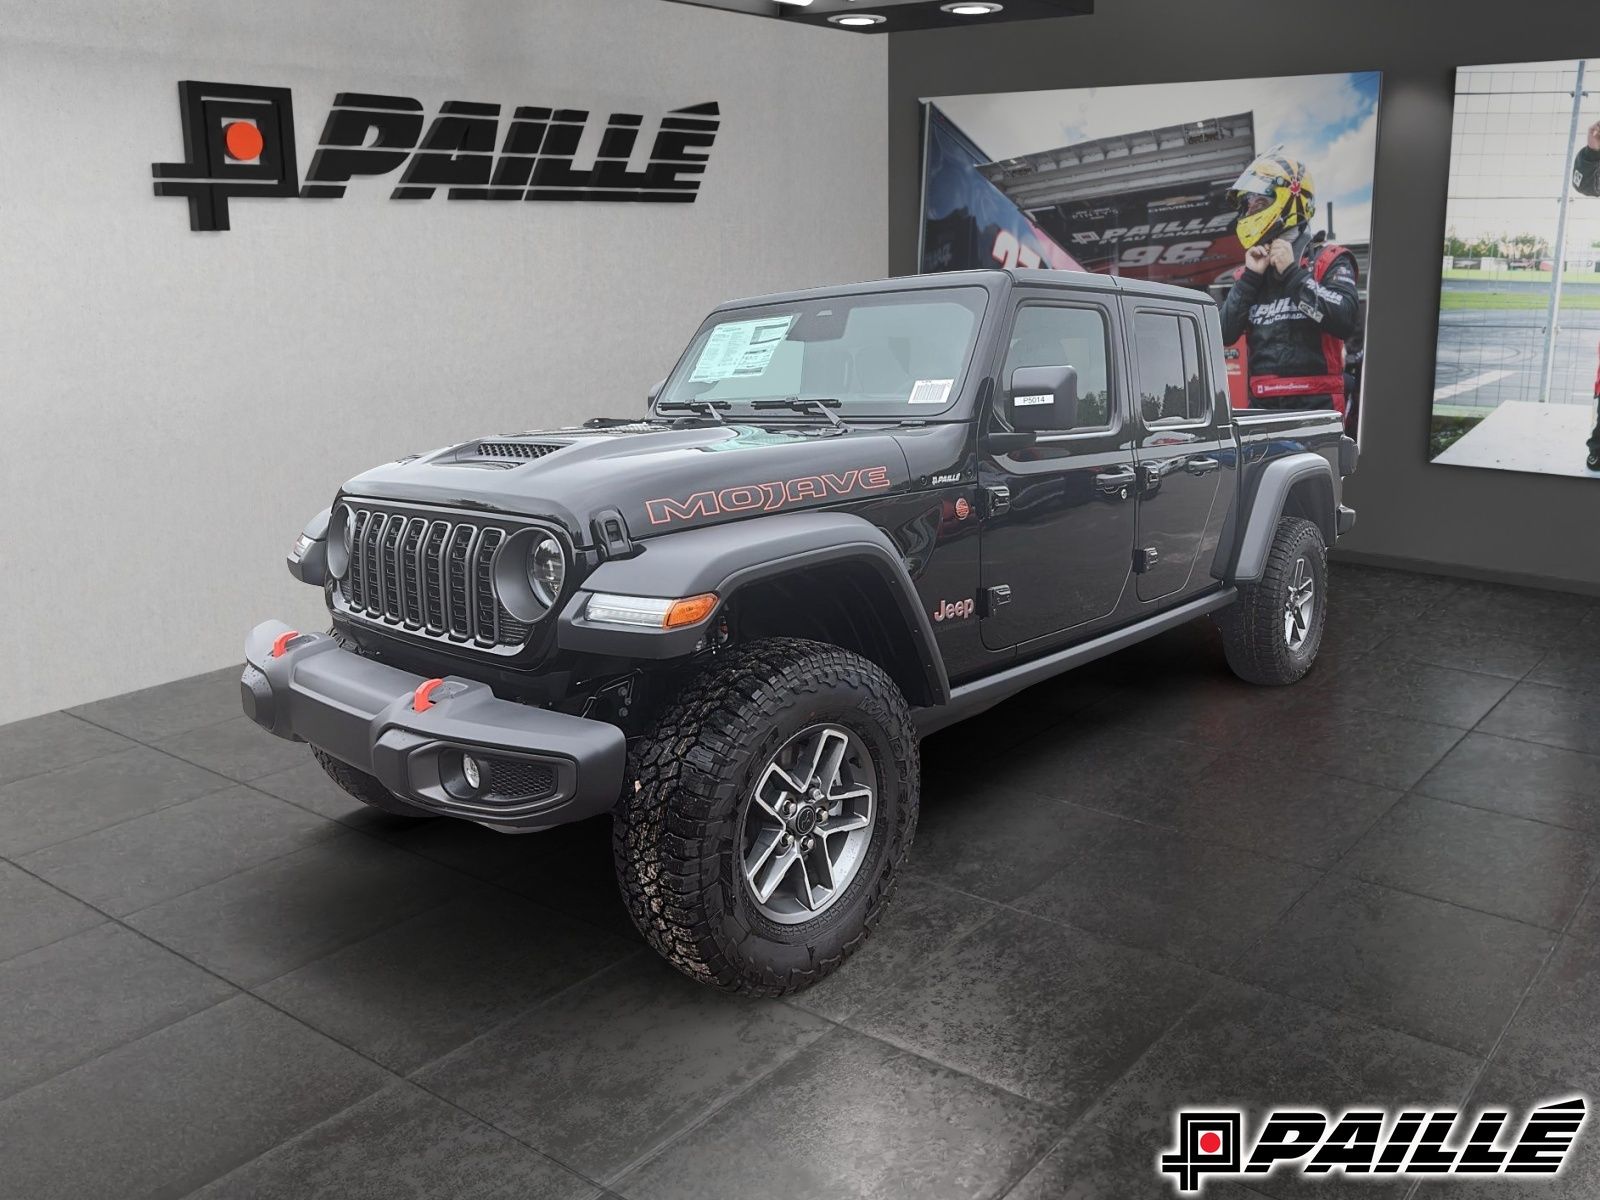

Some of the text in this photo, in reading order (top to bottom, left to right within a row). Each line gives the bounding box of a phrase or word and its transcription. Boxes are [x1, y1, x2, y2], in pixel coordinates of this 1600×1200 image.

[300, 92, 720, 203] PAILLÉ
[1118, 241, 1213, 268] 96
[1023, 396, 1045, 405] P5014
[645, 465, 890, 525] MOJAVE
[934, 597, 975, 623] Jeep
